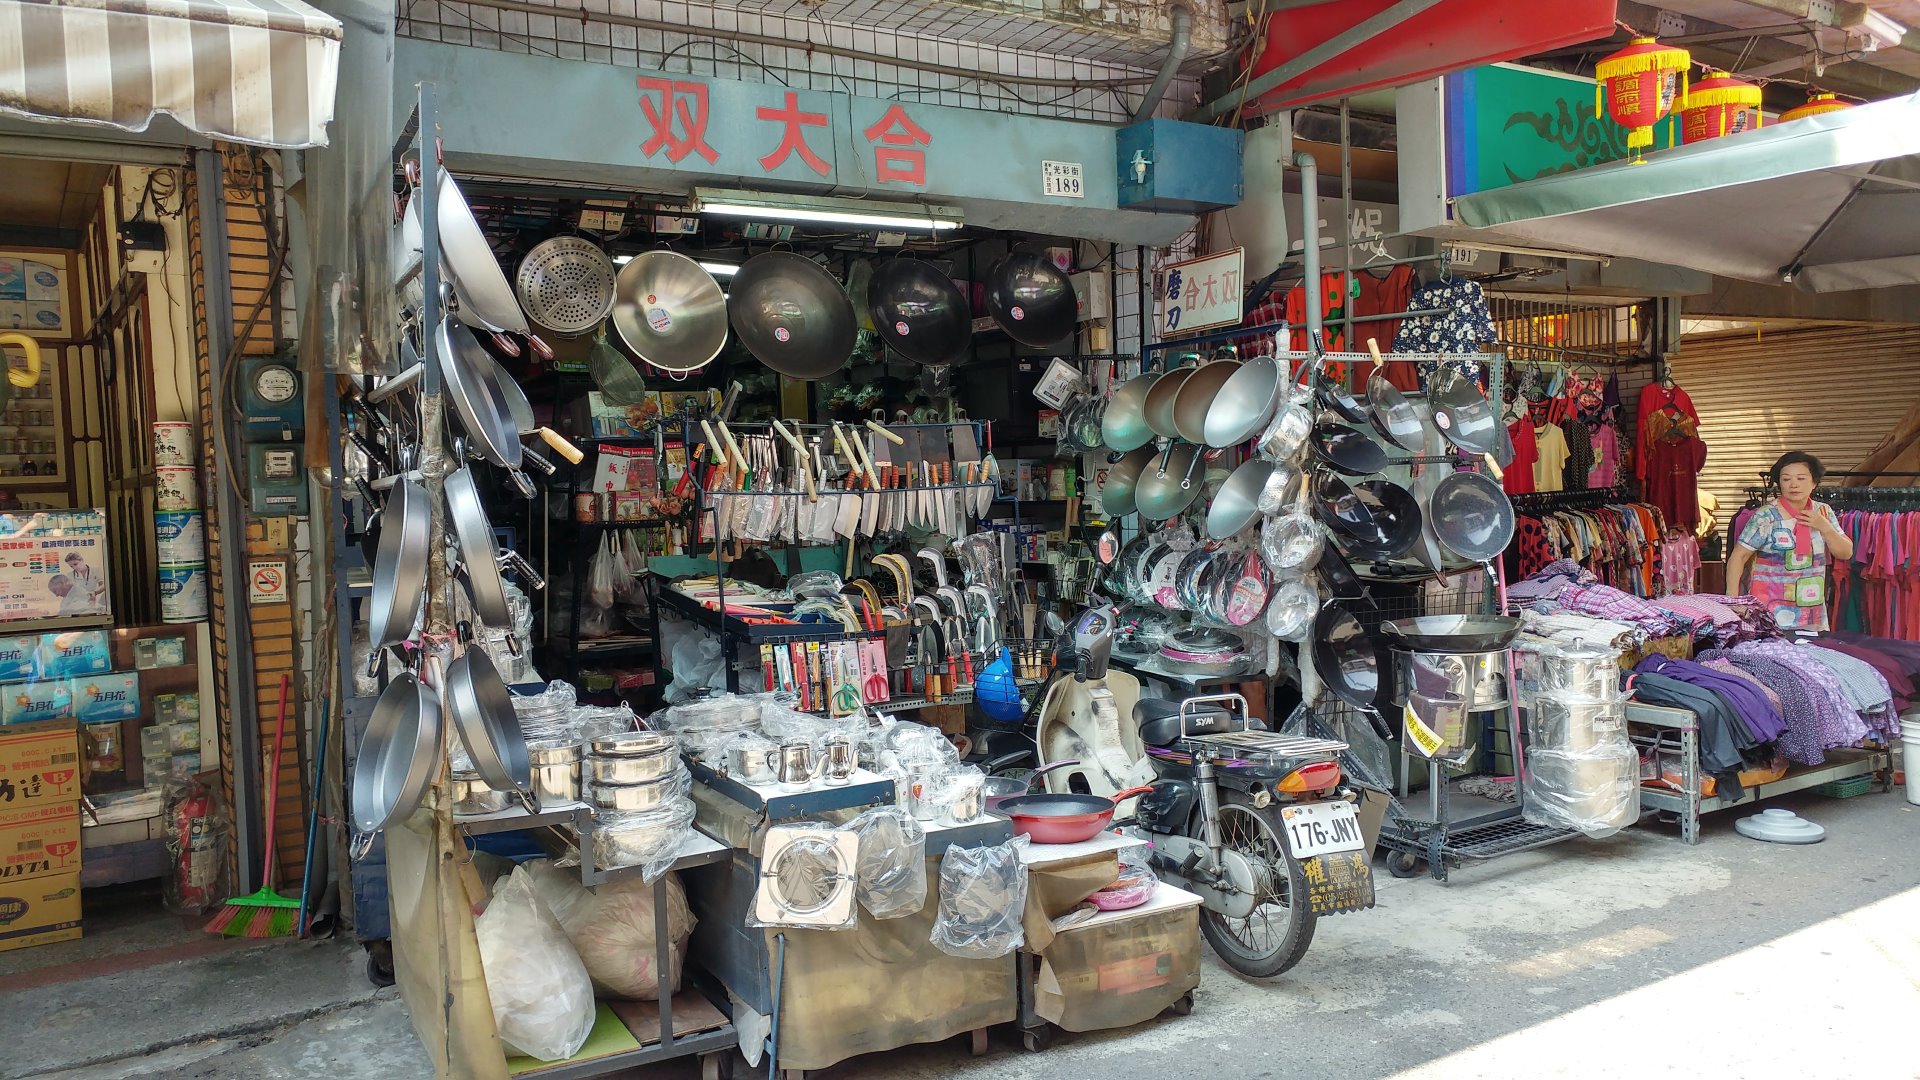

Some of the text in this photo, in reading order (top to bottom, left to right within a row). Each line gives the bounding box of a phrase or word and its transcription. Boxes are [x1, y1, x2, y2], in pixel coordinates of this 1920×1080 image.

[1053, 165, 1079, 176] 光彩街
[1055, 177, 1079, 194] 189
[1166, 269, 1182, 330] 磨刀
[63, 645, 93, 658] 五月花
[95, 691, 126, 703] 五月花
[1196, 717, 1214, 726] SYM
